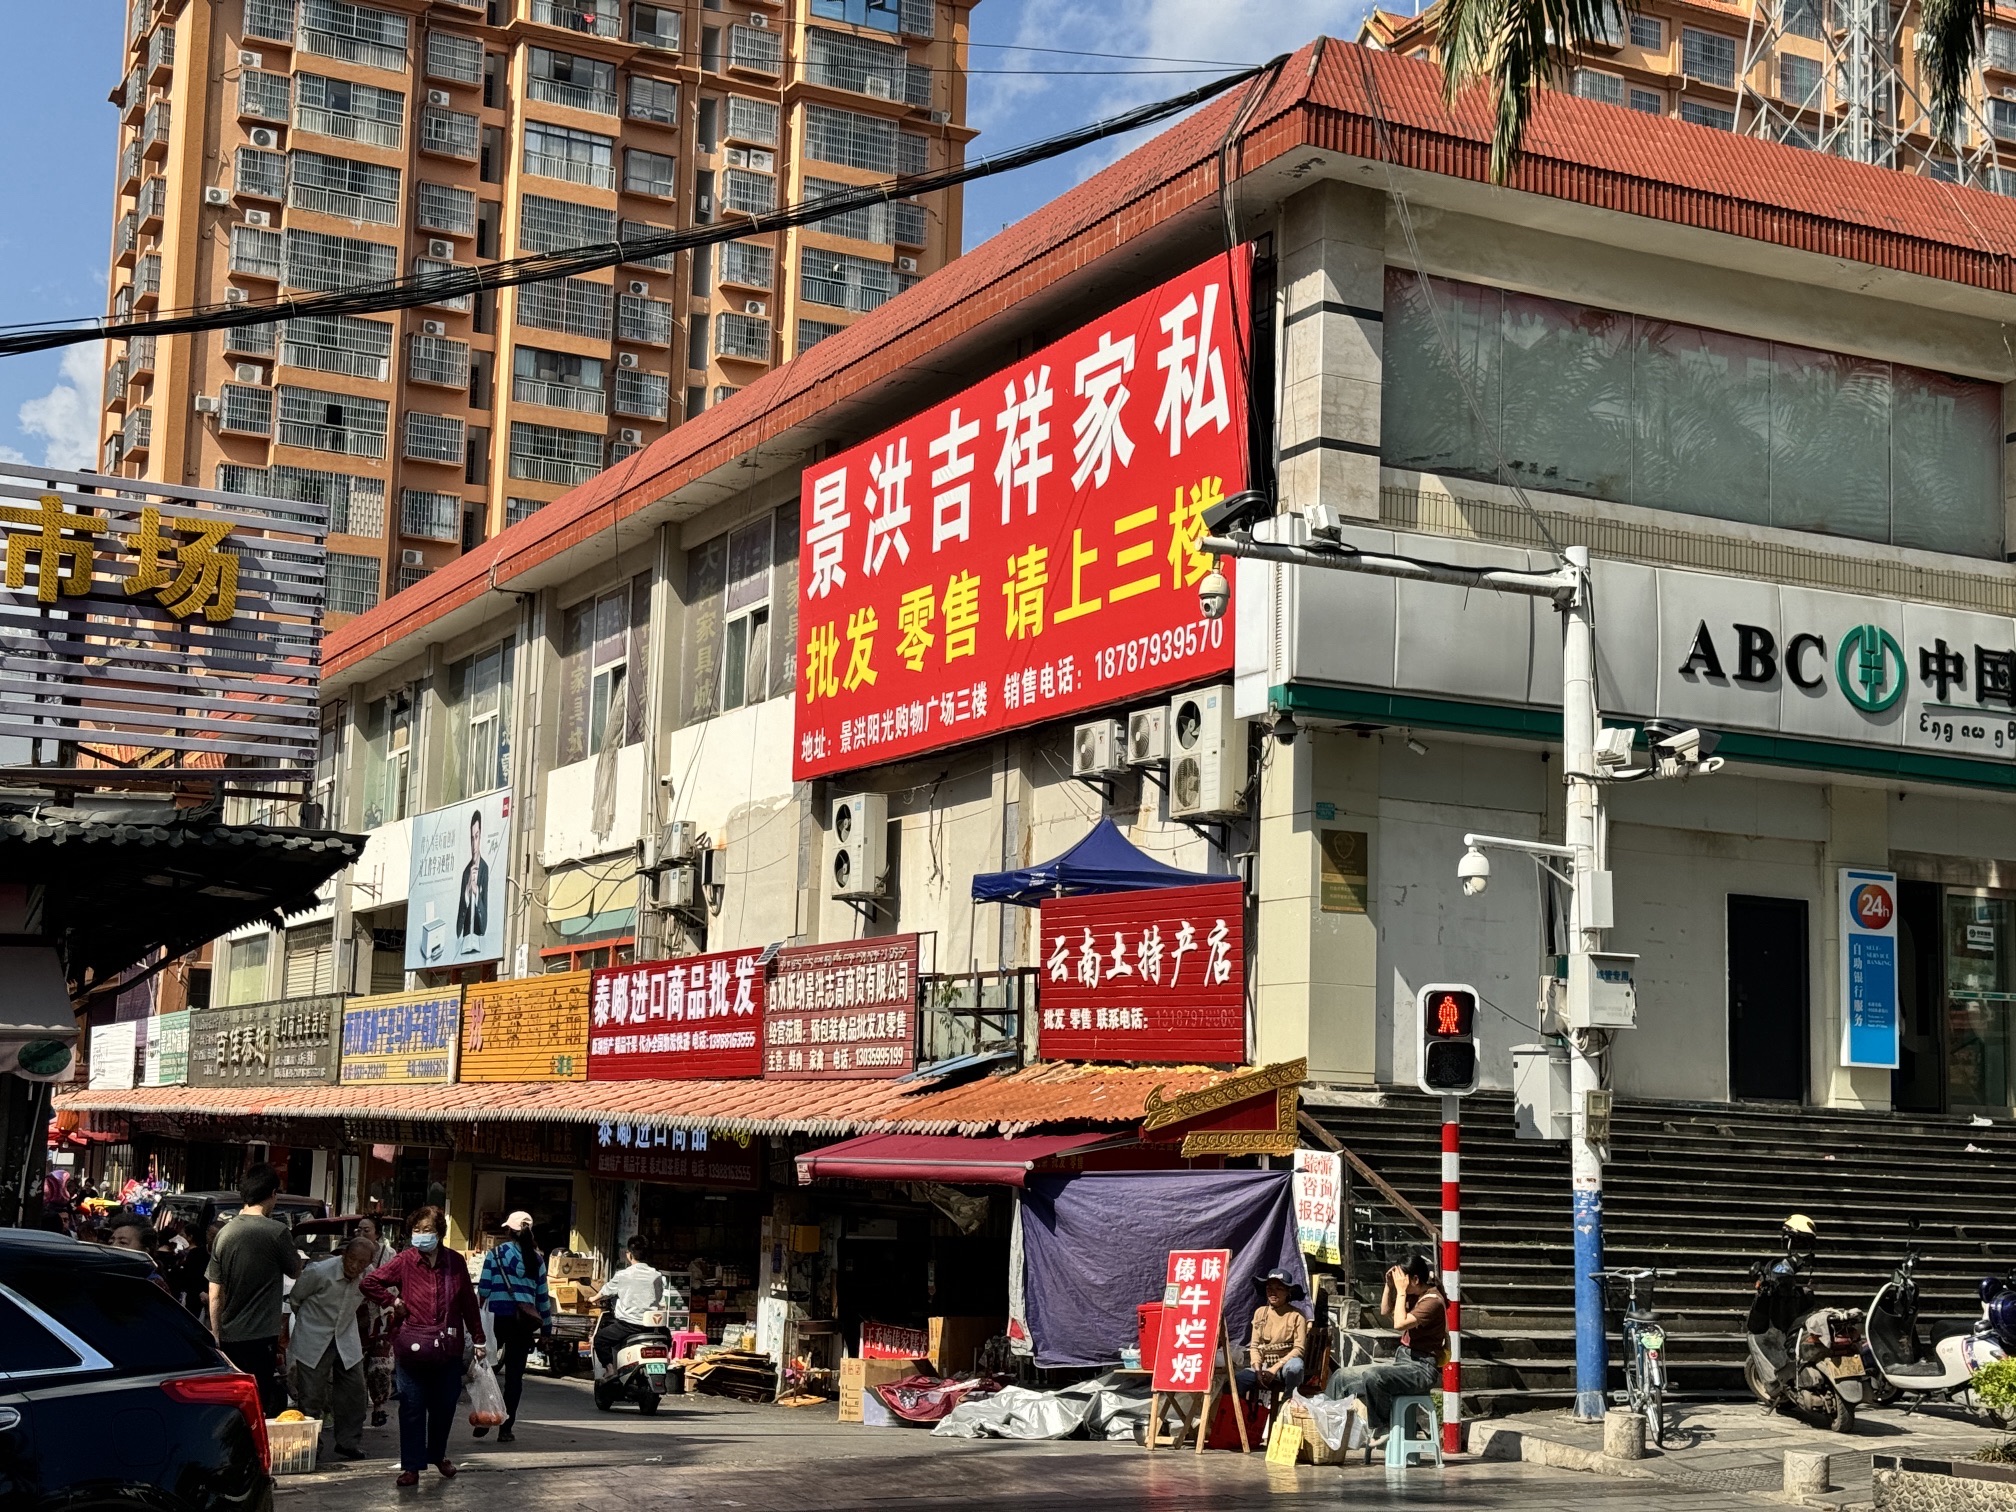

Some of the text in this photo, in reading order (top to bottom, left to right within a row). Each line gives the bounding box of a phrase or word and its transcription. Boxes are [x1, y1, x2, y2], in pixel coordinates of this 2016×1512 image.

[806, 283, 1231, 600] 景洪吉祥家私
[0, 495, 240, 622] 市场
[805, 606, 879, 704] 批发
[896, 568, 982, 674] 零售
[1004, 475, 1226, 642] 请上三楼
[1678, 619, 1826, 689] ABC
[1919, 638, 2016, 708] 中国
[1861, 893, 1890, 917] 24h
[1047, 918, 1232, 989] 云南土特产店
[1866, 959, 1892, 967] BANKING
[769, 961, 909, 1012] 西双版纳景洪志高商贸有限公司
[1852, 942, 1864, 1027] 自助银行服务
[1043, 1008, 1066, 1030] 批发
[1069, 1008, 1092, 1030] 零售
[1303, 1152, 1334, 1177] 旅游
[1303, 1176, 1333, 1200] 咨询
[1298, 1199, 1337, 1225] 报名处
[1173, 1257, 1222, 1283] 傣味
